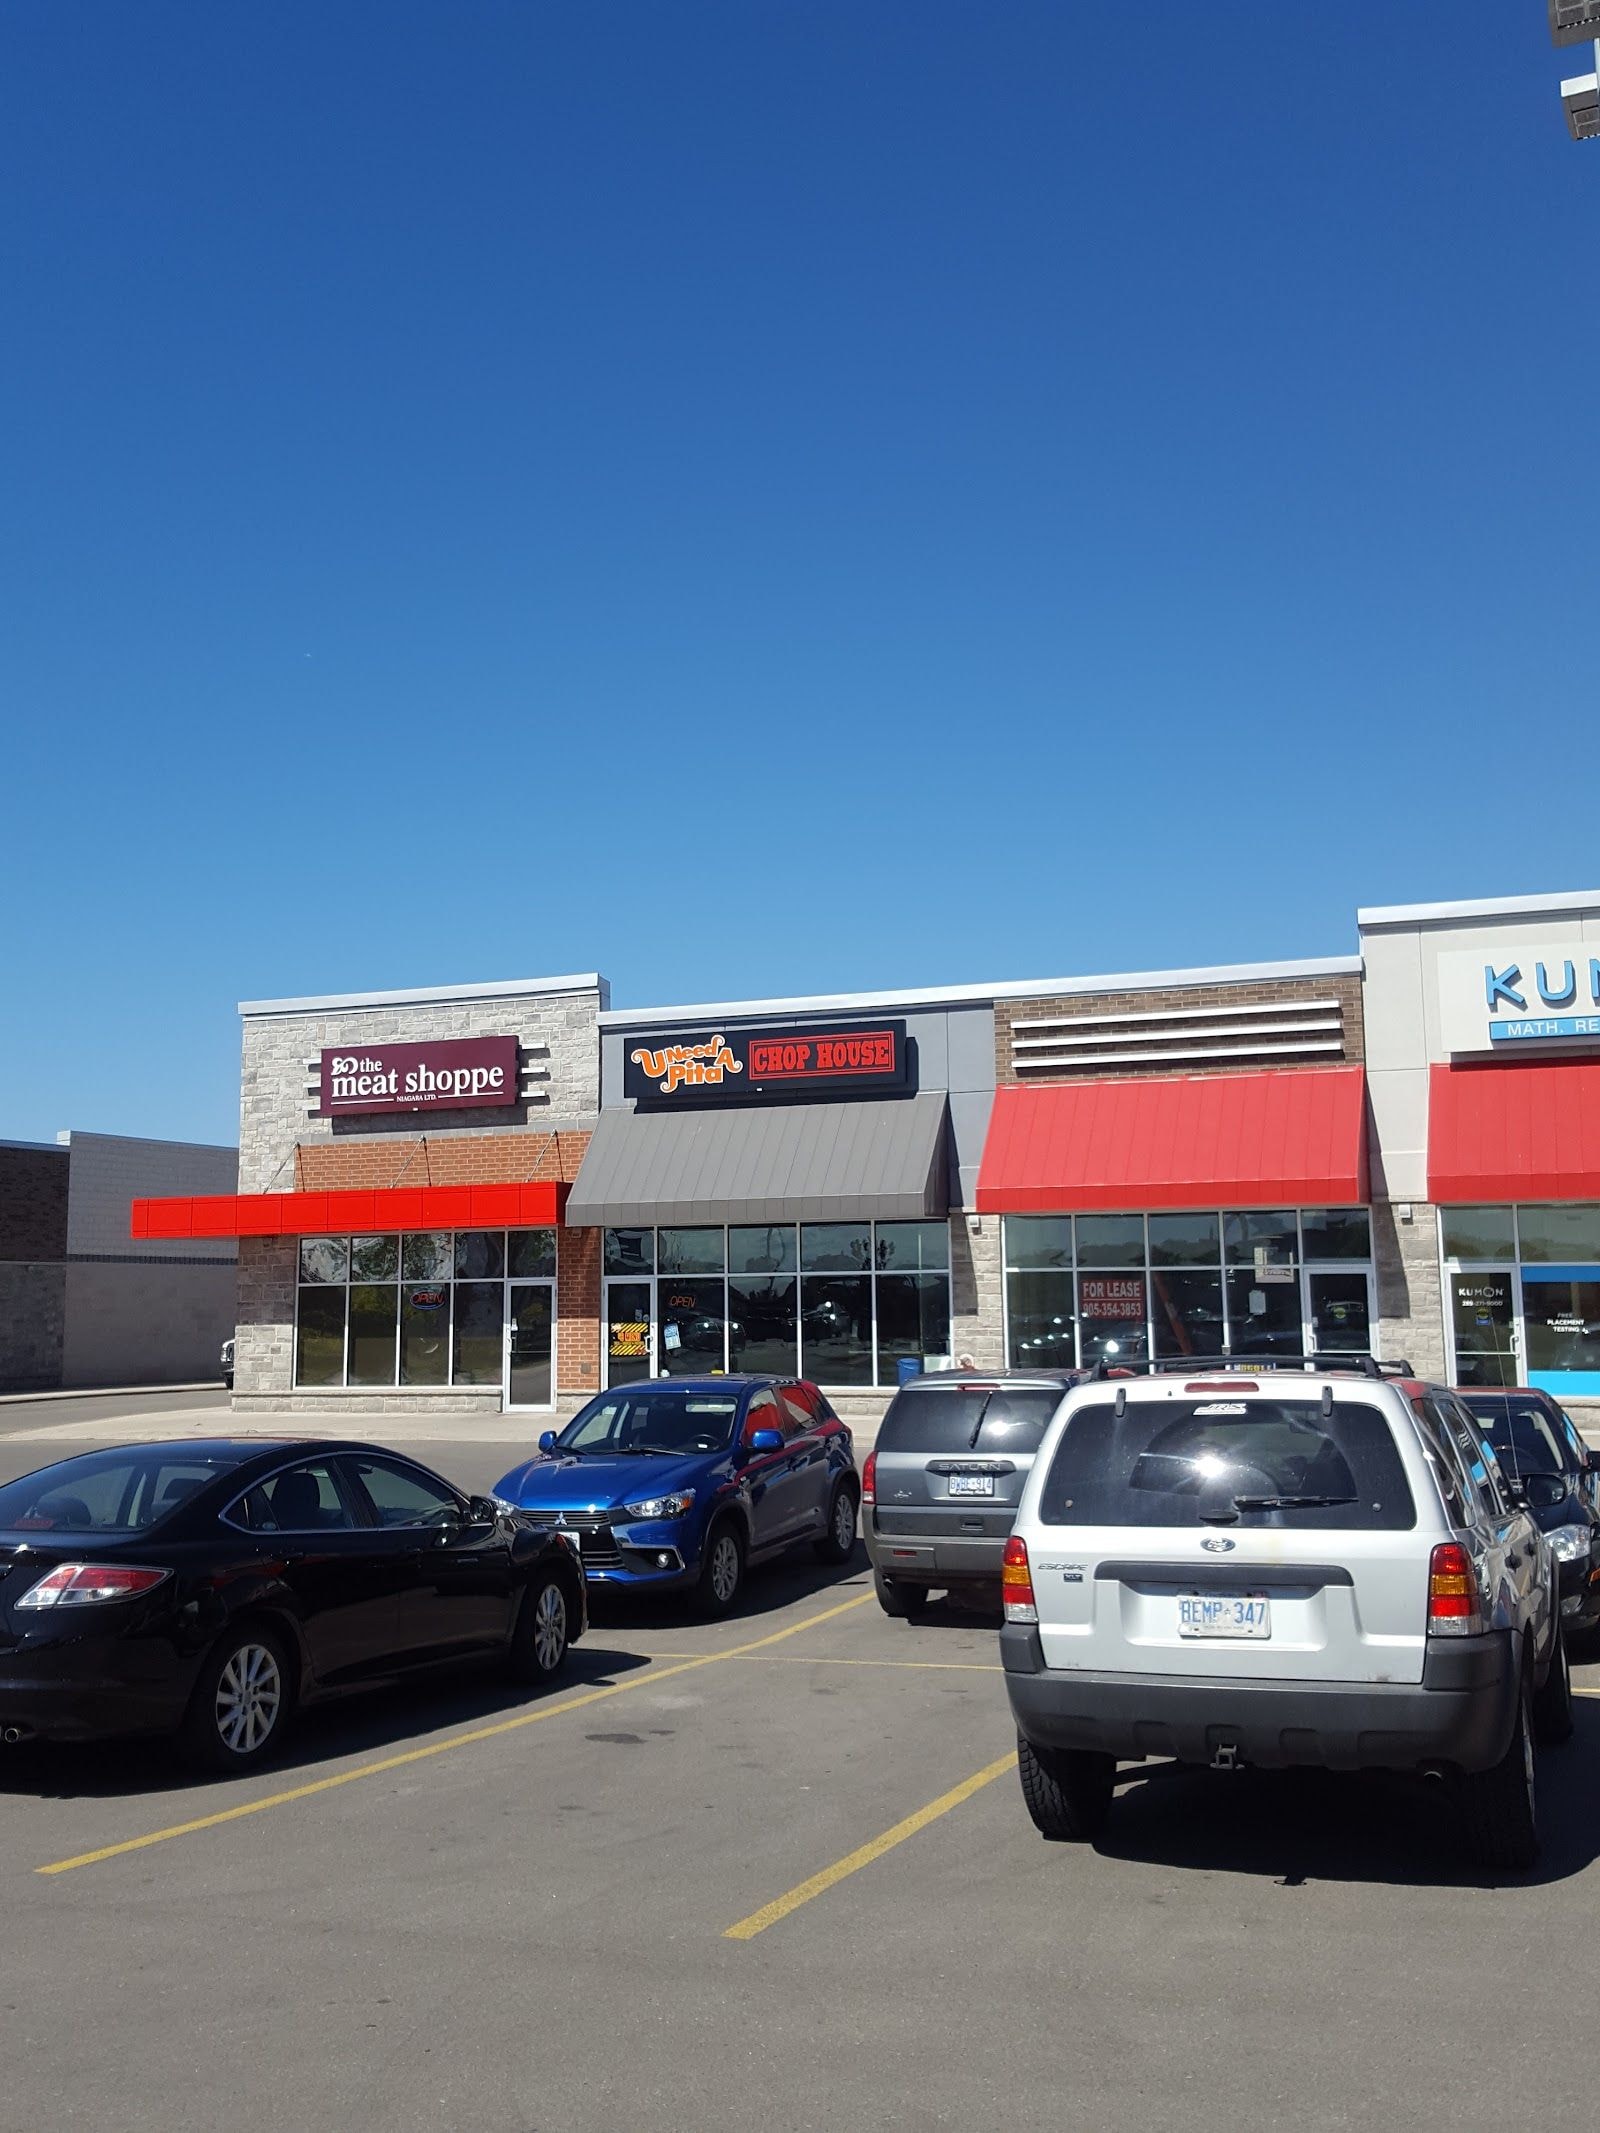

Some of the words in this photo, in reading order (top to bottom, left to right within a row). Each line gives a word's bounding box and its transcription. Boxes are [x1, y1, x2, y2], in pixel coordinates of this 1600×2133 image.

[1508, 1022, 1564, 1036] MATH.
[631, 1048, 667, 1078] U
[665, 1035, 725, 1063] Need
[714, 1047, 743, 1073] A
[754, 1046, 811, 1072] CHOP
[816, 1040, 890, 1068] HOUSE
[359, 1057, 383, 1073] the
[331, 1068, 399, 1098] meat
[405, 1063, 504, 1097] shoppe
[660, 1060, 724, 1093] Pita
[396, 1095, 424, 1103] NIAGARA
[1083, 1282, 1104, 1297] FOR
[1107, 1282, 1140, 1297] LEASE
[412, 1292, 443, 1304] OPEN
[670, 1295, 696, 1308] OPEN
[1083, 1303, 1141, 1316] 905-354-3853
